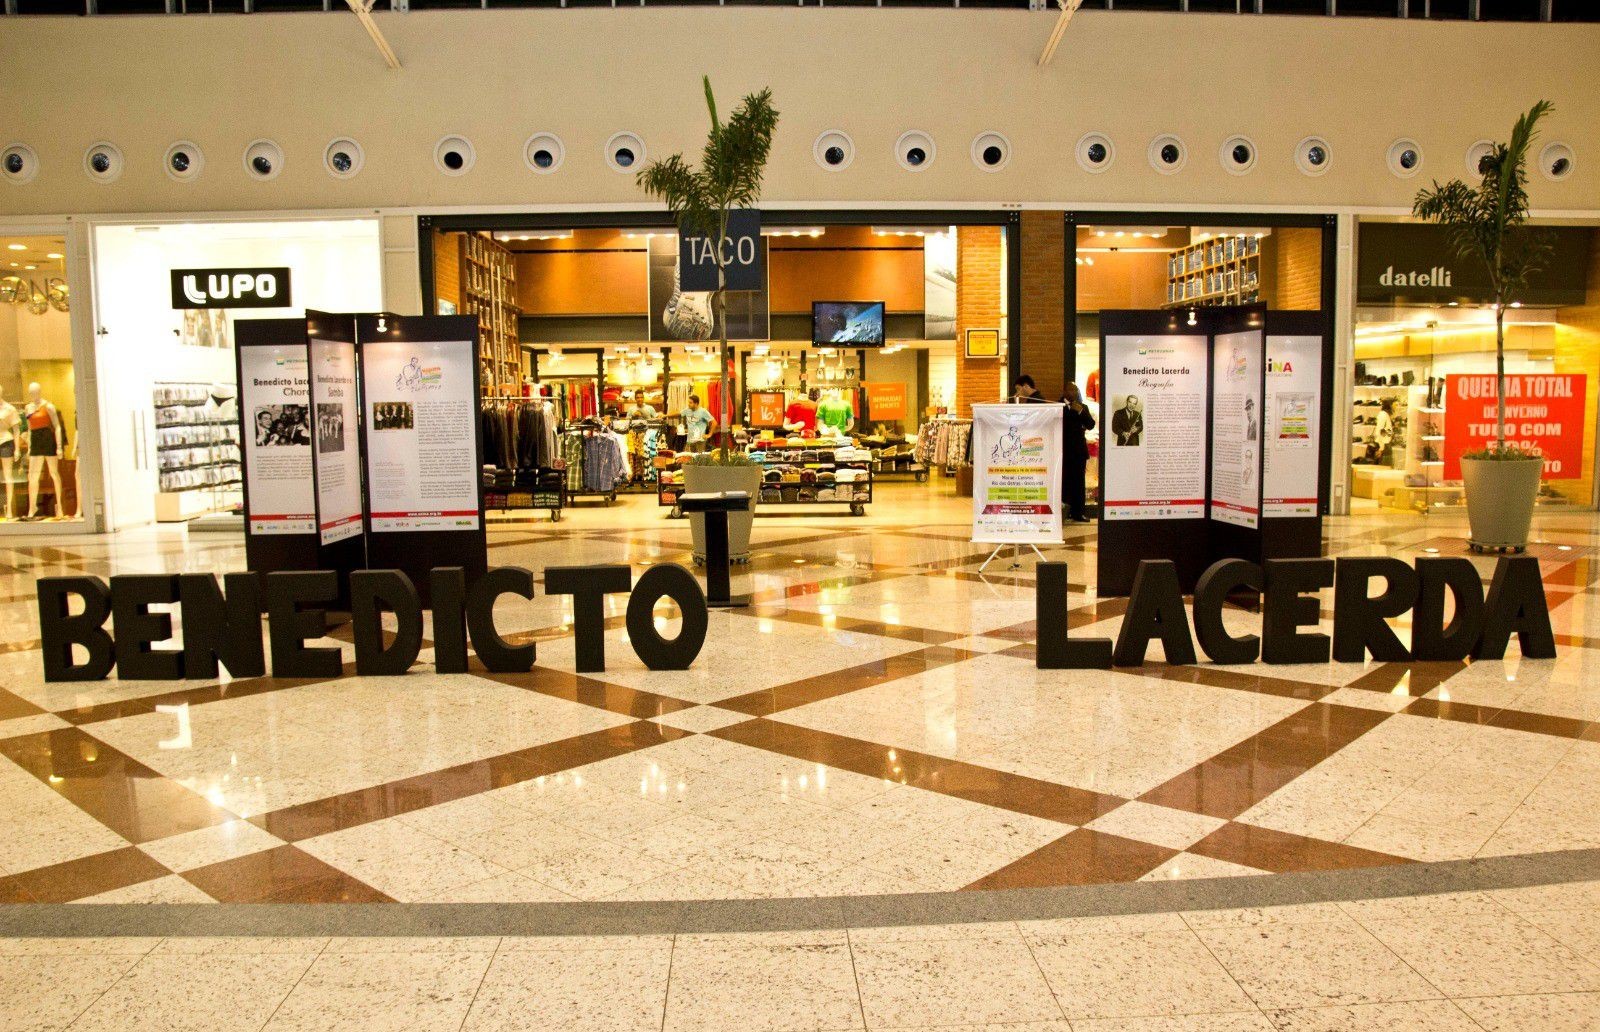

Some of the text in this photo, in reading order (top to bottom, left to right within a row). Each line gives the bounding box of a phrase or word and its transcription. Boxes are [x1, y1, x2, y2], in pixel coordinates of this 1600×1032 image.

[685, 235, 755, 265] TACO
[1379, 265, 1451, 287] datelli
[183, 273, 277, 304] LUPO
[253, 377, 291, 386] Benedicto
[1123, 366, 1190, 375] Benedicto Lacerda
[1525, 376, 1573, 398] TOTAL
[1504, 405, 1548, 419] NVERNO
[1520, 423, 1562, 437] COM
[36, 563, 709, 682] BENEDICTO
[1036, 557, 1557, 669] LACERDA
